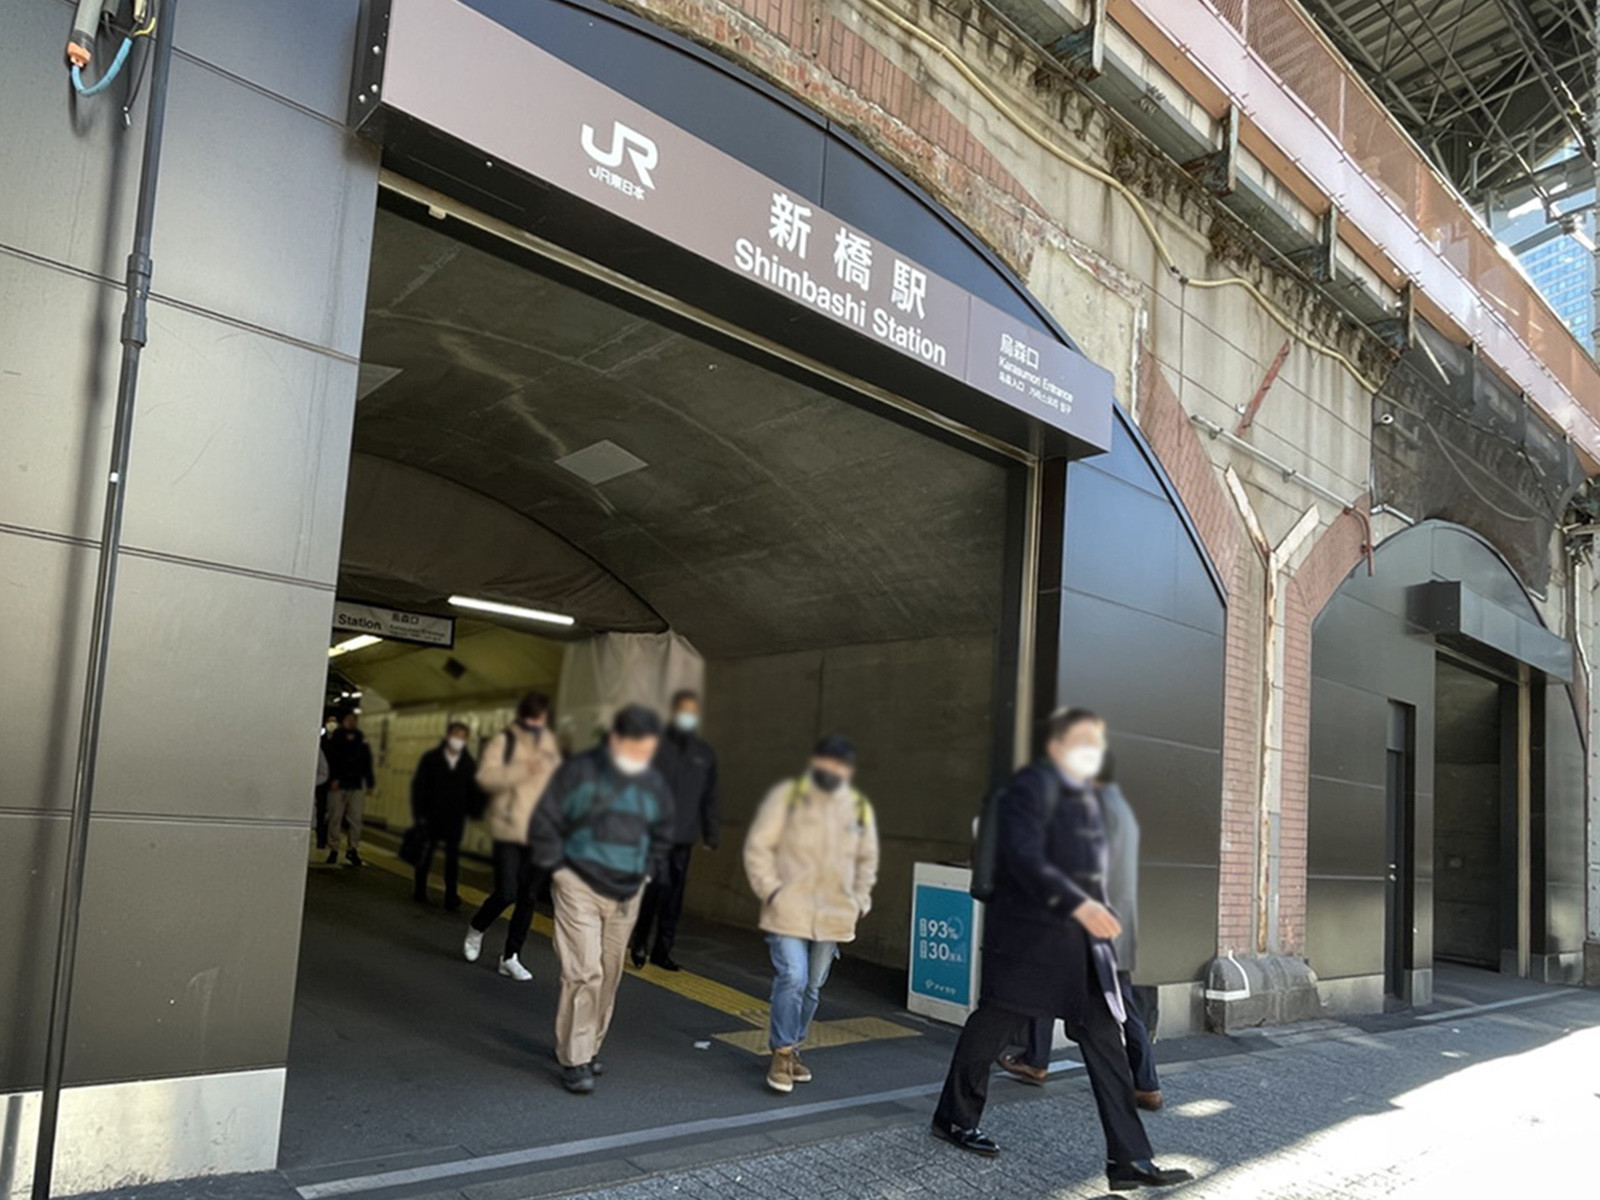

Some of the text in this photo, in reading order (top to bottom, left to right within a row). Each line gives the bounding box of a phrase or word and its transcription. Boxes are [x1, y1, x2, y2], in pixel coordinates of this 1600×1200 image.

[581, 120, 659, 191] JR
[734, 238, 947, 366] Shimbashi Station
[338, 613, 382, 631] Station
